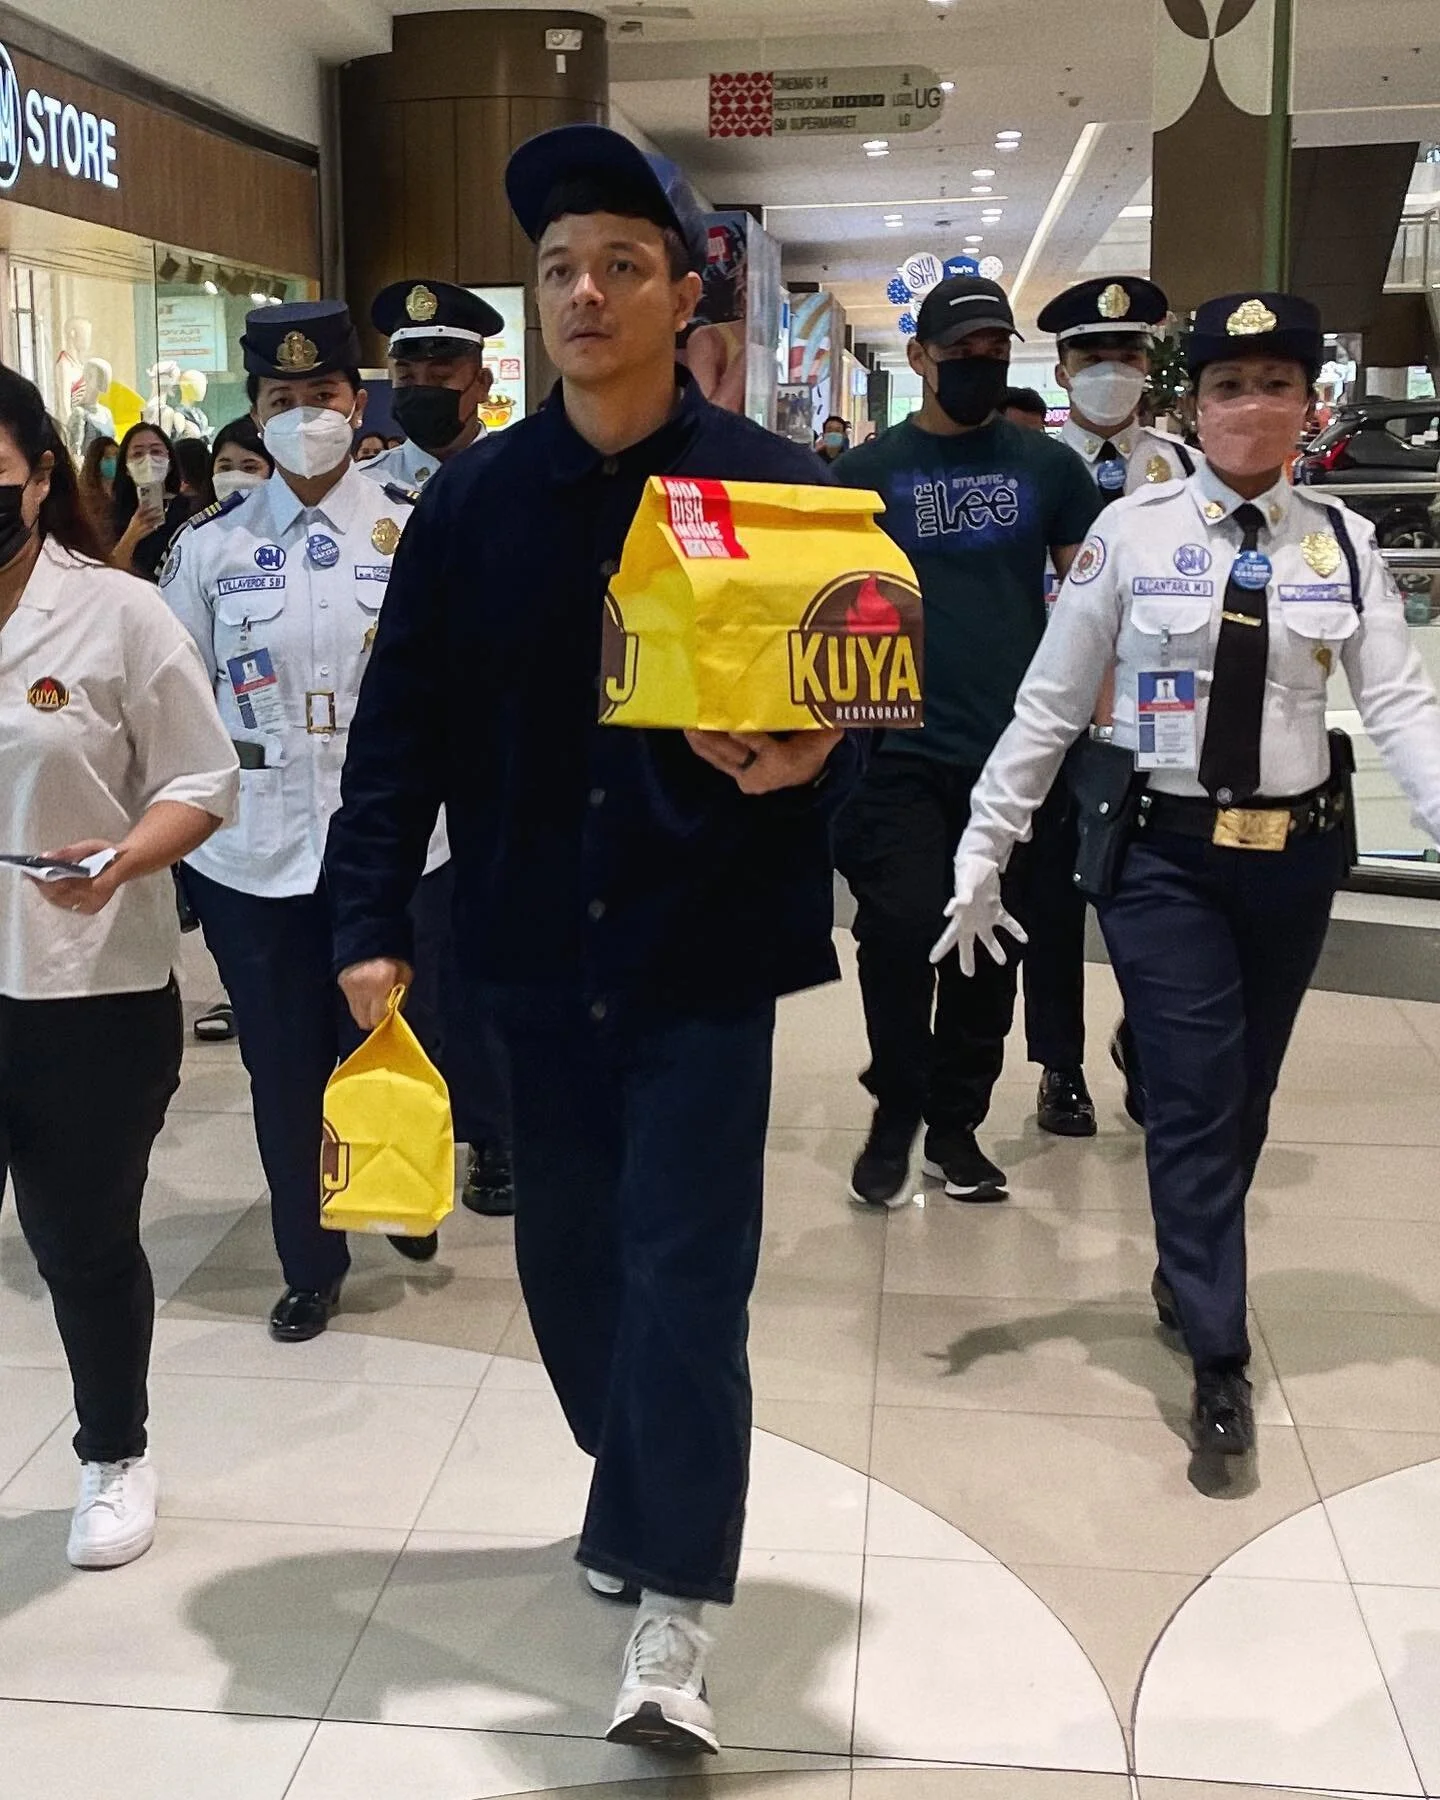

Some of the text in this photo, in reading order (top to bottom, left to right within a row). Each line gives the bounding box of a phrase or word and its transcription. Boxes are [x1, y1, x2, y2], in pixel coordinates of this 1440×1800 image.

[915, 87, 941, 109] UG
[790, 115, 857, 131] SUPERMARKET
[25, 88, 119, 189] STORE
[665, 480, 704, 500] BIDA
[671, 499, 704, 523] DISH
[933, 480, 1019, 534] Lee
[672, 521, 724, 541] INSIDE
[222, 577, 267, 592] VILLAVERDE
[1137, 580, 1190, 593] ALCANTARA
[605, 633, 638, 702] J
[789, 631, 923, 702] KUYA
[26, 688, 59, 705] KUYA
[835, 705, 917, 722] RESTAURANT
[323, 1143, 349, 1191] J
